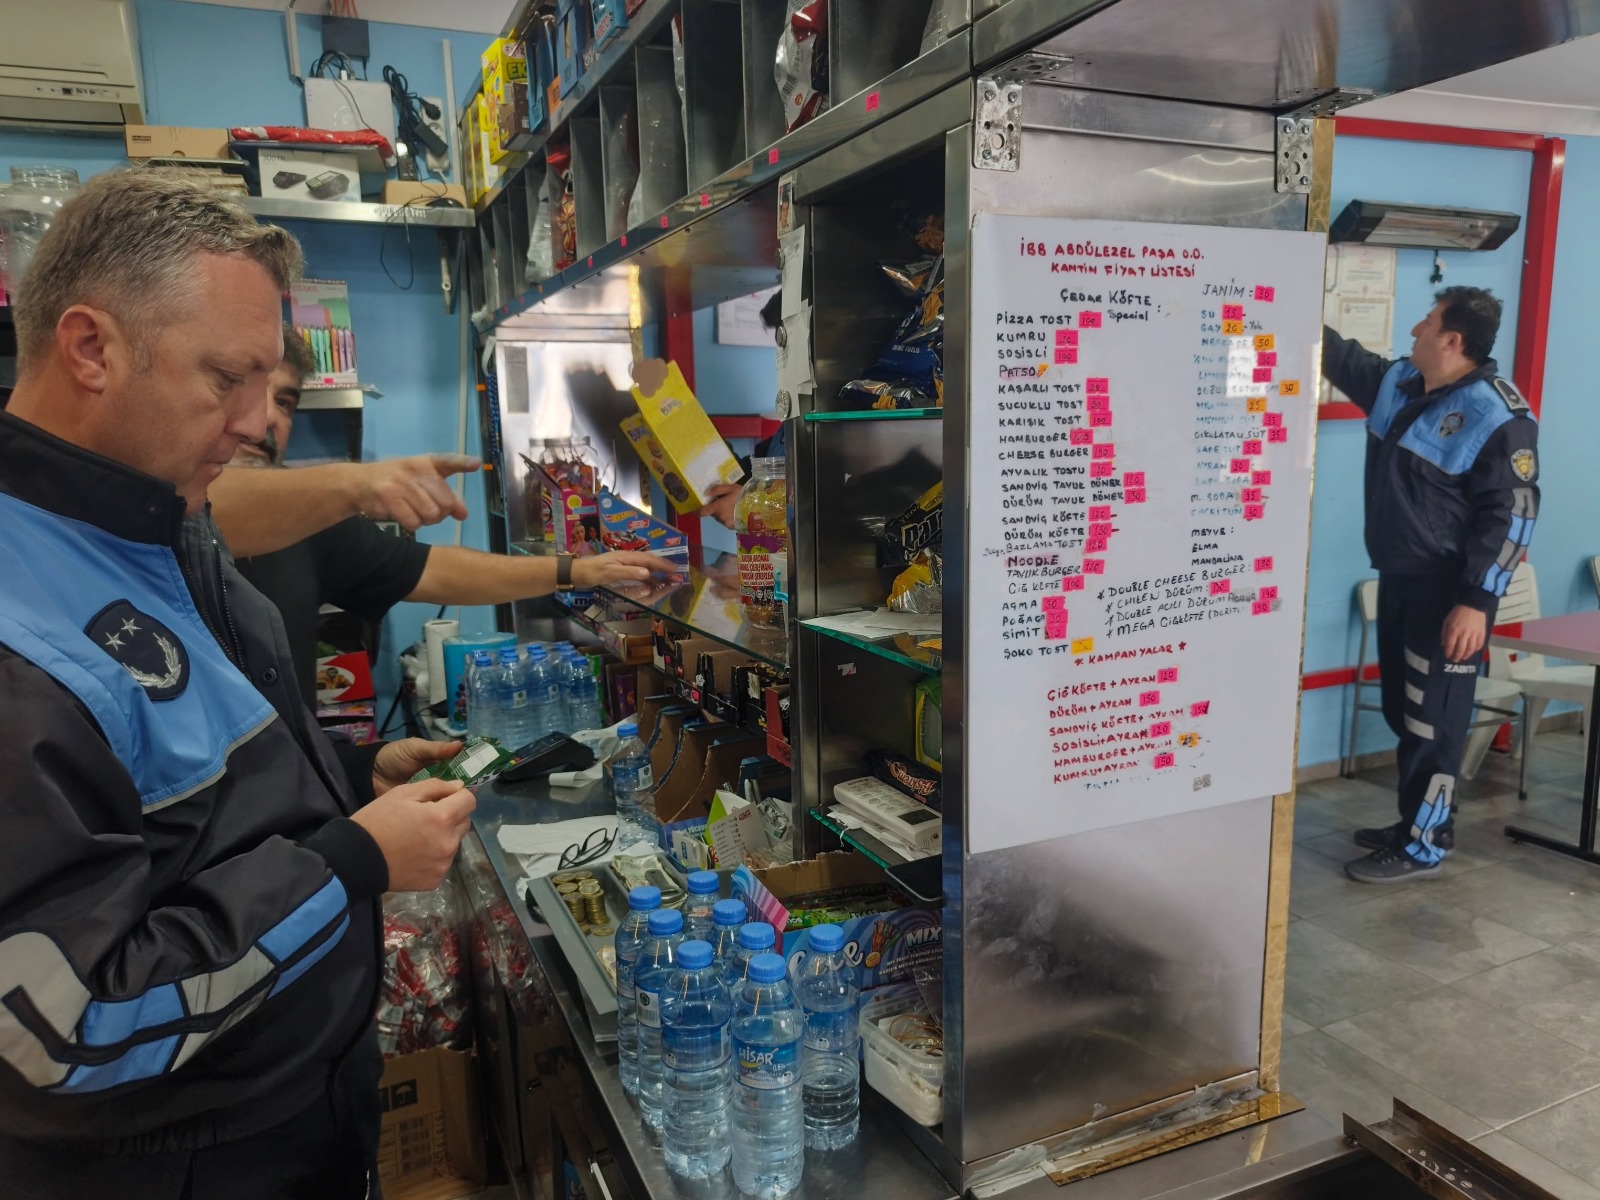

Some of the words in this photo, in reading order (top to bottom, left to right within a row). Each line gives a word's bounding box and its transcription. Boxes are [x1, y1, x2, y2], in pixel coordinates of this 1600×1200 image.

[1020, 237, 1046, 256] İBB
[1054, 240, 1135, 258] ABDÜLEZEL
[1142, 246, 1175, 260] PAŞA
[1051, 262, 1097, 275] KANTİN
[1104, 263, 1145, 277] FİYAT
[1109, 289, 1152, 306] KÖFTE
[996, 311, 1034, 325] PİZZA
[1040, 314, 1072, 325] TOST
[1201, 309, 1215, 319] SU
[996, 331, 1046, 343] KUMRU
[997, 346, 1047, 359] SOSİSLİ
[999, 364, 1036, 378] PATSO
[998, 384, 1049, 395] KAŞARLI
[1052, 383, 1081, 394] TOST
[998, 401, 1050, 411] SUCUKLU
[1056, 399, 1084, 410] TOST
[998, 417, 1046, 428] KARIŞIK
[1054, 415, 1082, 426] TOST
[999, 432, 1068, 444] HAMBURGER
[998, 450, 1045, 460] CHEESE
[1049, 447, 1089, 459] BURGER
[1001, 467, 1048, 477] AYVALIK
[1052, 466, 1085, 475] TOSTU
[1053, 480, 1086, 490] TAVUK
[1002, 493, 1043, 509] DÜRÜM
[1050, 495, 1086, 505] TAVUK
[1052, 510, 1086, 523] KÖFTE
[1004, 527, 1042, 541] DÜRÜM
[1048, 526, 1085, 539] KÖFTE
[1191, 543, 1219, 554] ELMA
[1007, 554, 1059, 568] NOODLE
[1191, 553, 1244, 566] MANDALİNA
[1108, 580, 1150, 597] DOUBLE
[1154, 572, 1196, 588] CHEESE
[1165, 585, 1203, 599] DÜRÜM
[1002, 627, 1040, 640] SİMİT
[1117, 620, 1155, 637] MEGA
[1038, 644, 1069, 657] TOST
[1049, 704, 1087, 719] DÜRÜM
[1099, 698, 1132, 711] AYRAN
[738, 1046, 778, 1066] HİSAR
